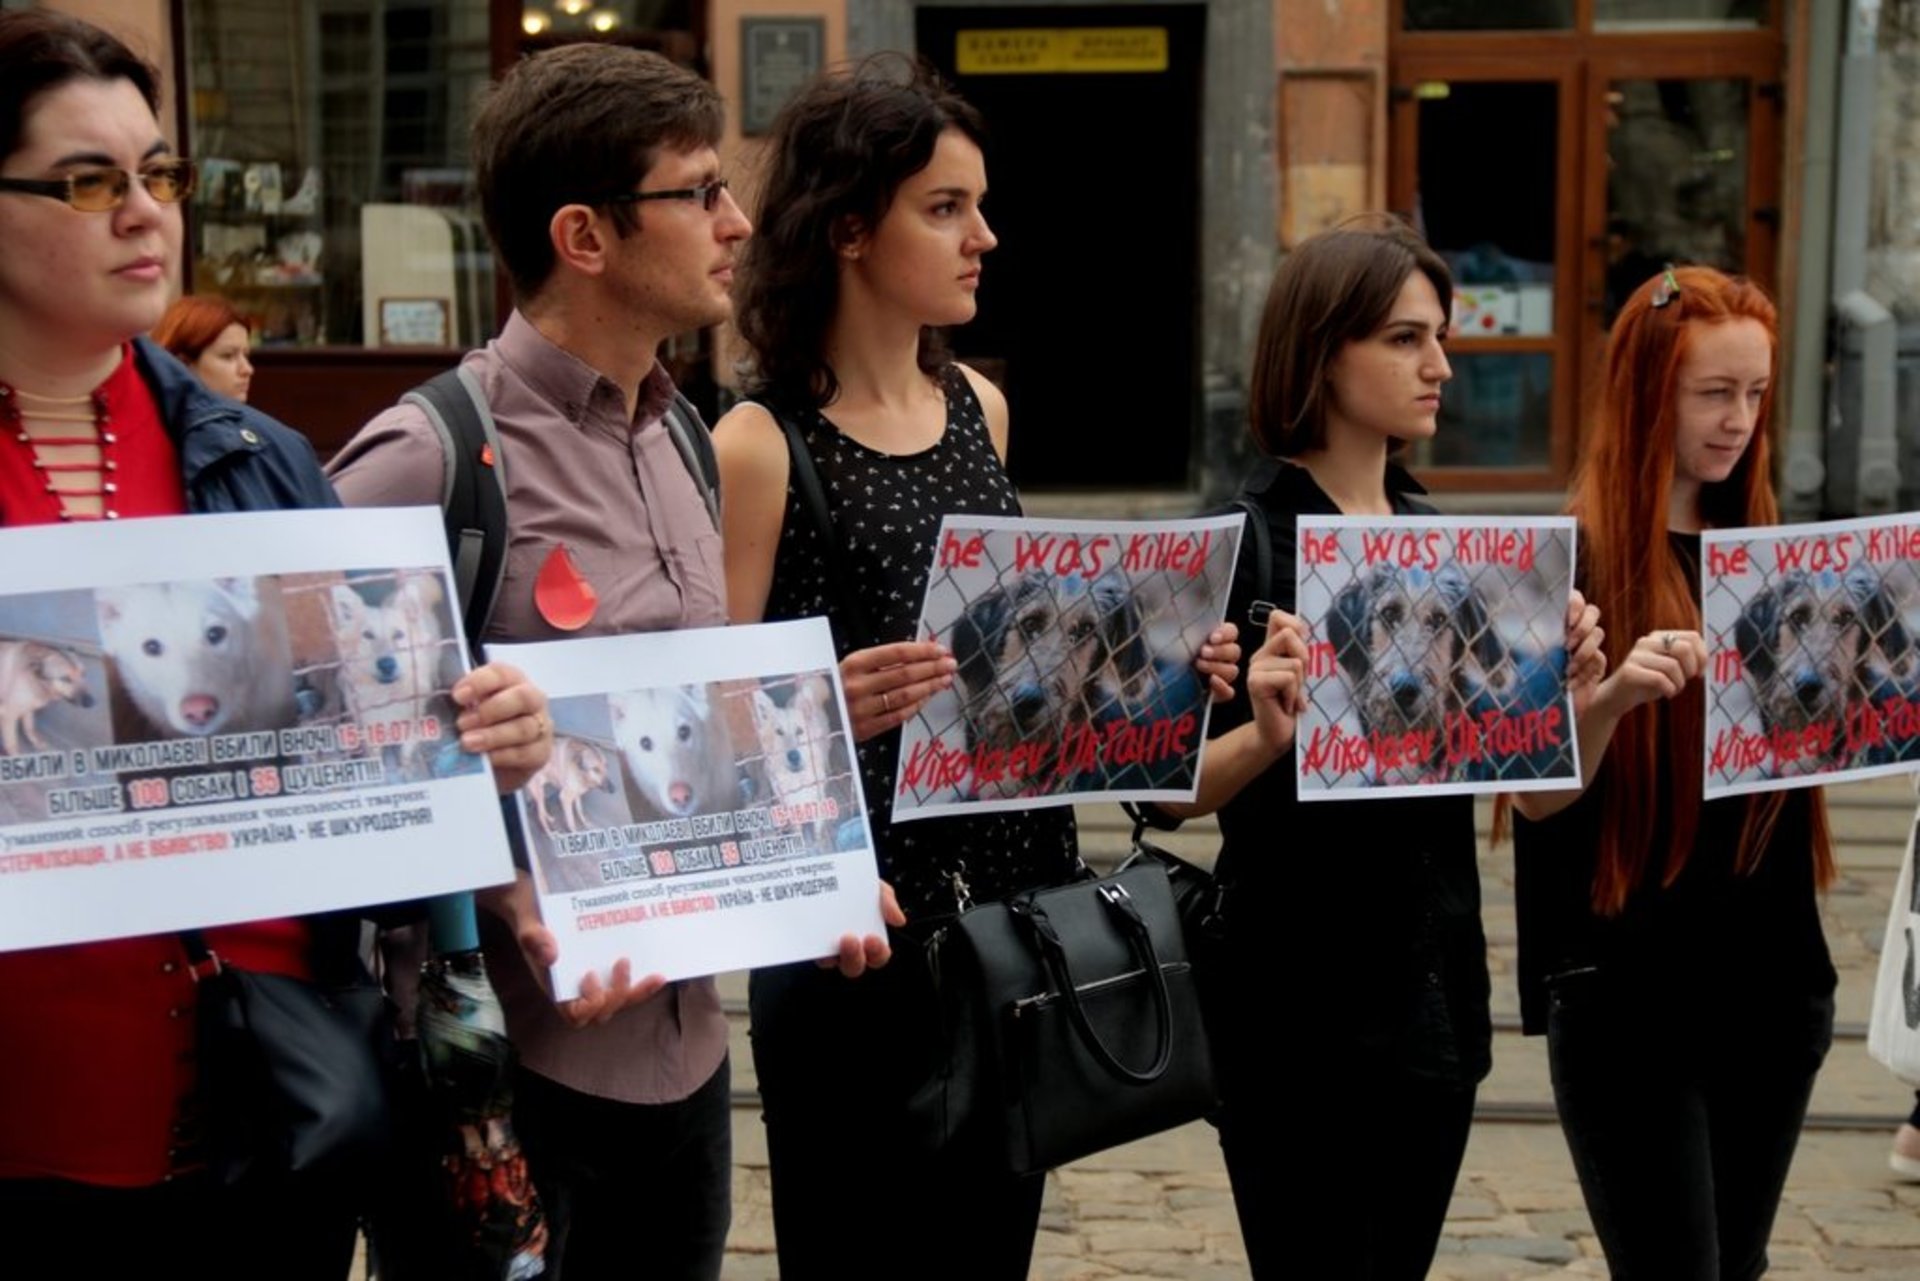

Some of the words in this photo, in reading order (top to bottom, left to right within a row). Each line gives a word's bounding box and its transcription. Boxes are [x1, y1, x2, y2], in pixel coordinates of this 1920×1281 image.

[939, 528, 985, 569] he
[1016, 535, 1110, 580] was
[1302, 529, 1339, 563] he
[1362, 531, 1440, 571] was
[1707, 542, 1748, 576] he
[1774, 536, 1853, 574] was
[1714, 636, 1743, 684] in
[1, 755, 63, 780] ВБИЛИ
[76, 753, 86, 773] В
[213, 735, 274, 760] ВБИЛИ
[282, 730, 332, 752] ВНОЧІ
[49, 786, 121, 813] БІЛЬШЕ
[129, 779, 166, 806] 100
[173, 775, 231, 801] СОБАК
[251, 768, 279, 792] 35
[88, 819, 142, 838] спосіб
[233, 824, 297, 848] УКРАЇНА
[308, 821, 326, 840] НЕ
[650, 850, 675, 874] 100
